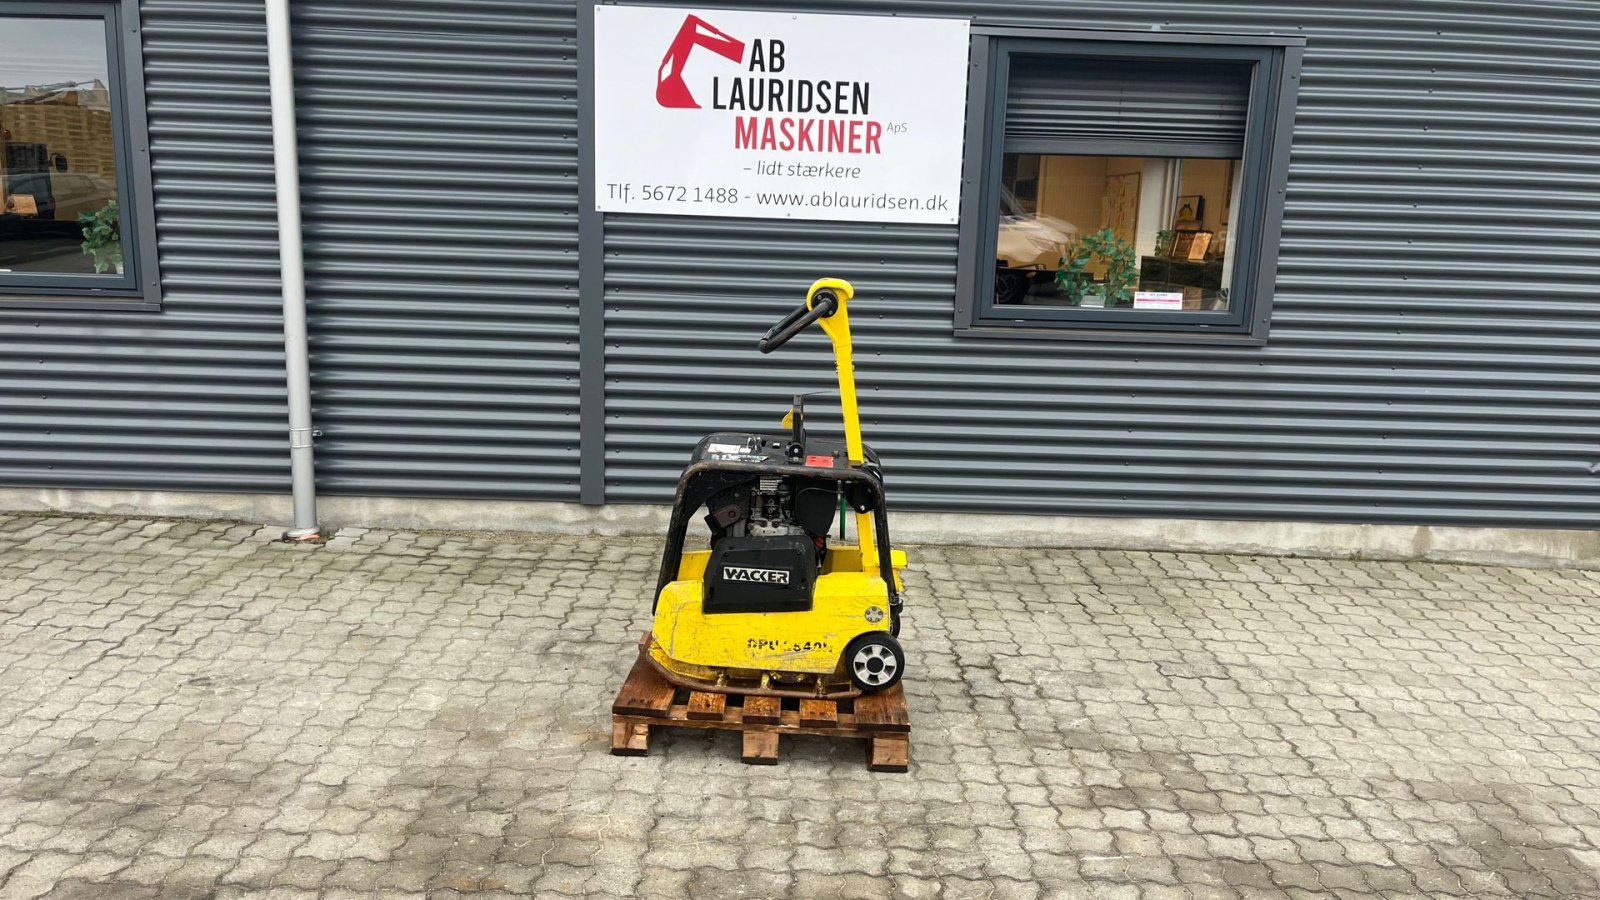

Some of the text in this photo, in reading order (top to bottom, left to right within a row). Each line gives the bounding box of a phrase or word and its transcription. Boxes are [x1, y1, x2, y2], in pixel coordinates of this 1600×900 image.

[748, 38, 786, 74] AB
[712, 75, 870, 116] LAURIDSEN
[734, 115, 908, 155] MASKINER ApS
[756, 160, 784, 177] lidt
[787, 162, 861, 180] stærkere
[606, 183, 636, 204] Tlf.
[641, 184, 687, 202] 5672
[693, 186, 738, 204] 1488
[756, 190, 949, 211] www.ablauridsen.dk
[723, 567, 789, 584] WACKER
